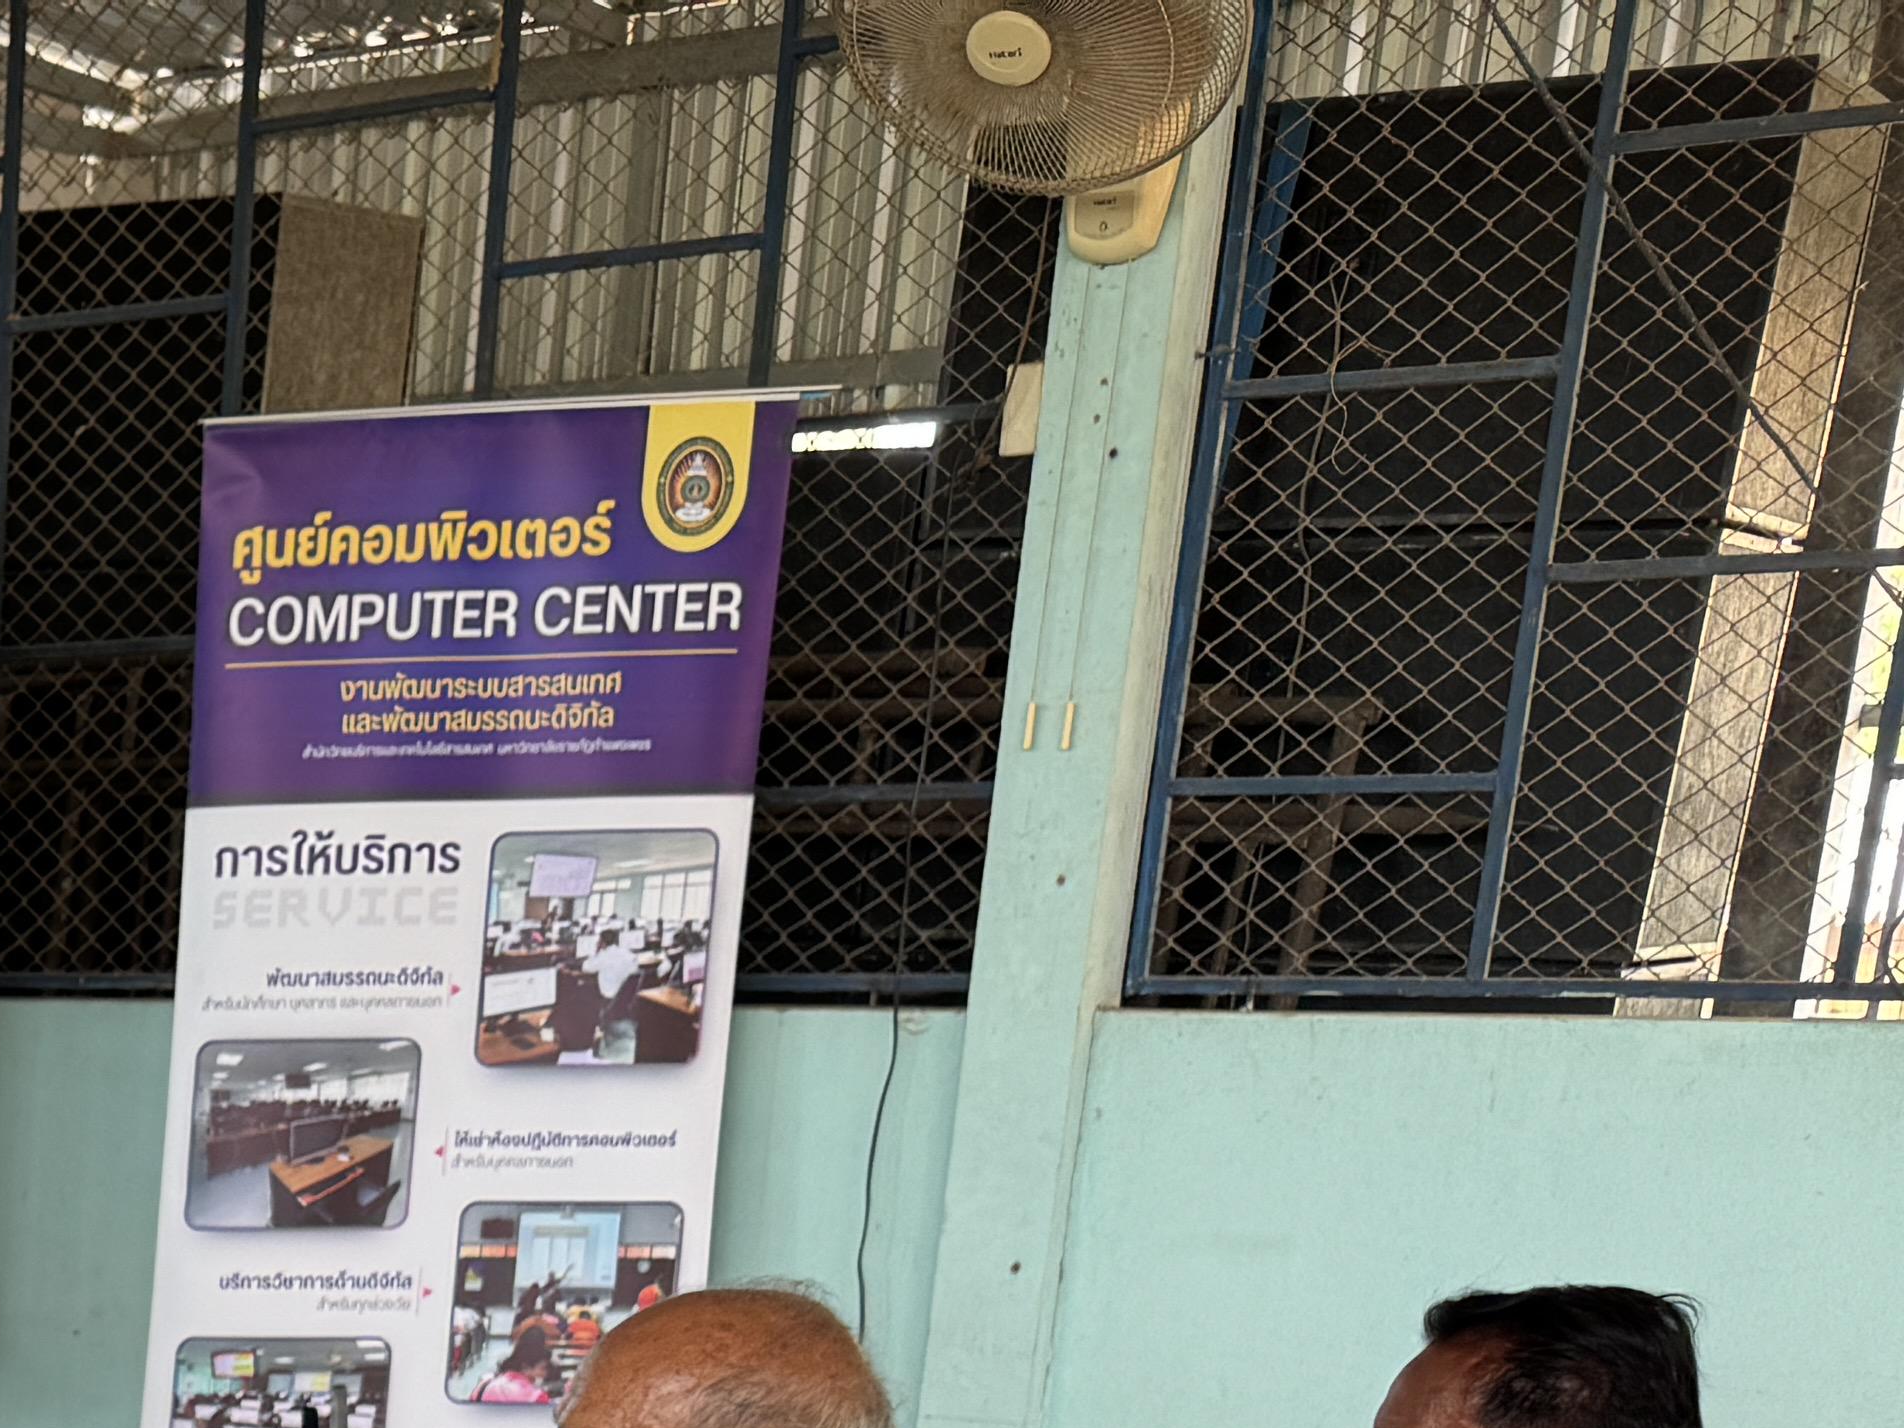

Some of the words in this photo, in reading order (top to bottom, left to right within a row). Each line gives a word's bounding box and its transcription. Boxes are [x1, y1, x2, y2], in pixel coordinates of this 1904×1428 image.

[232, 499, 616, 585] ศูนย์คอมพิวเตอร์
[228, 590, 518, 648] COMPUTER
[533, 581, 743, 640] CENTER
[340, 671, 623, 703] งานพัฒนาระบบสารสนเทศ
[342, 700, 615, 735] และพัฒนาสมรรถนะดิจิทัล
[213, 825, 463, 880] การให้บริการ
[212, 884, 461, 933] SERVICE
